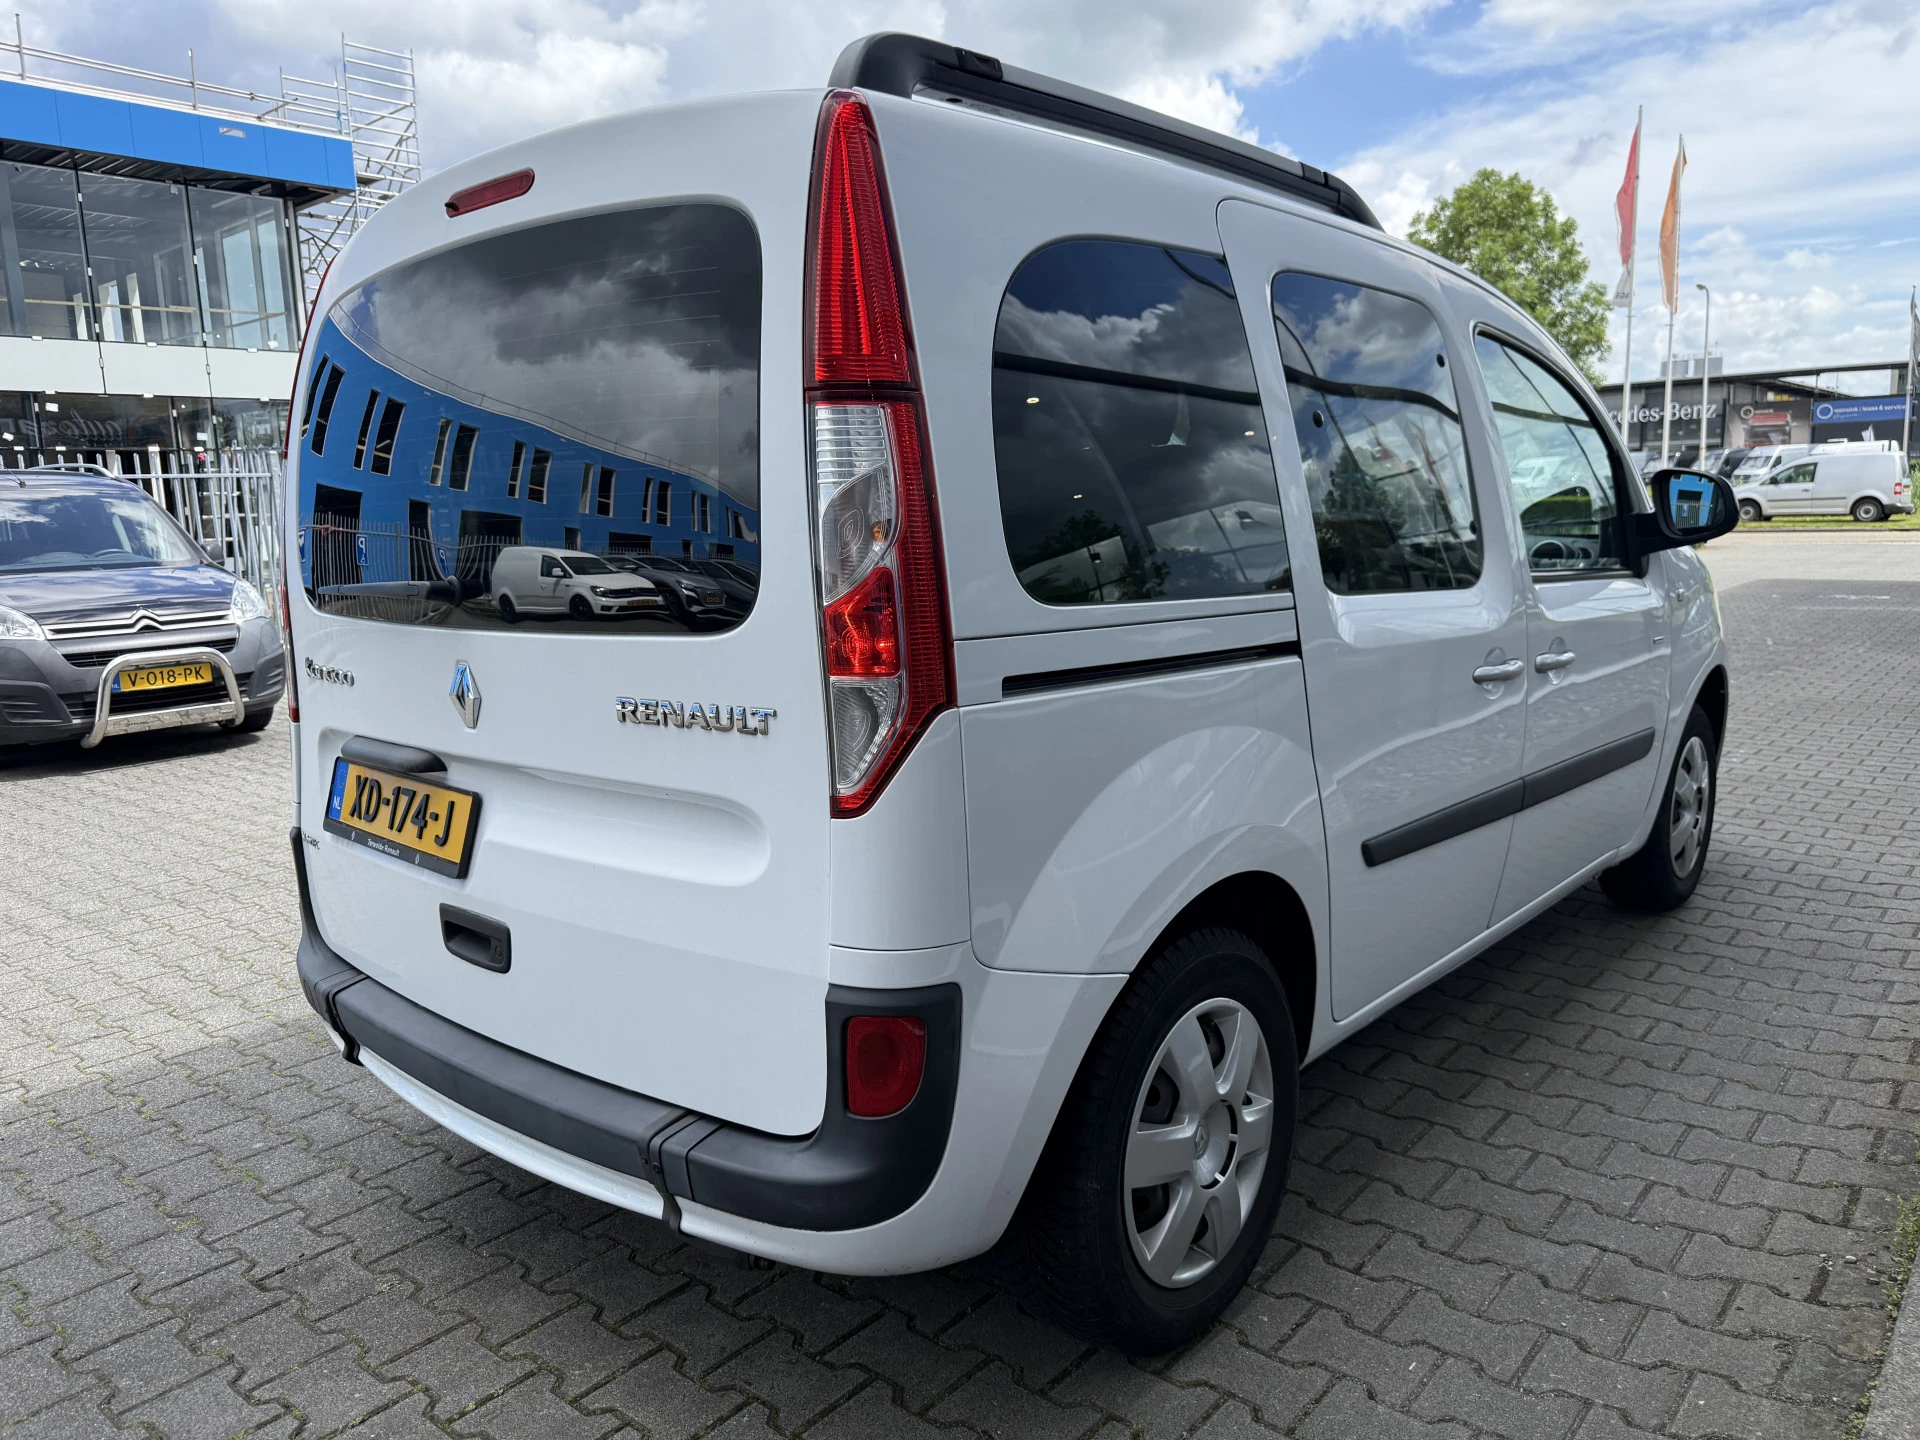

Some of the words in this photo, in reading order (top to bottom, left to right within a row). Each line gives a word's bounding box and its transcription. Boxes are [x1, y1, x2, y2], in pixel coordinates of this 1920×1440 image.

[127, 666, 205, 687] V-018-PK
[615, 696, 778, 736] RENAULT
[348, 774, 456, 847] XD-174-J
